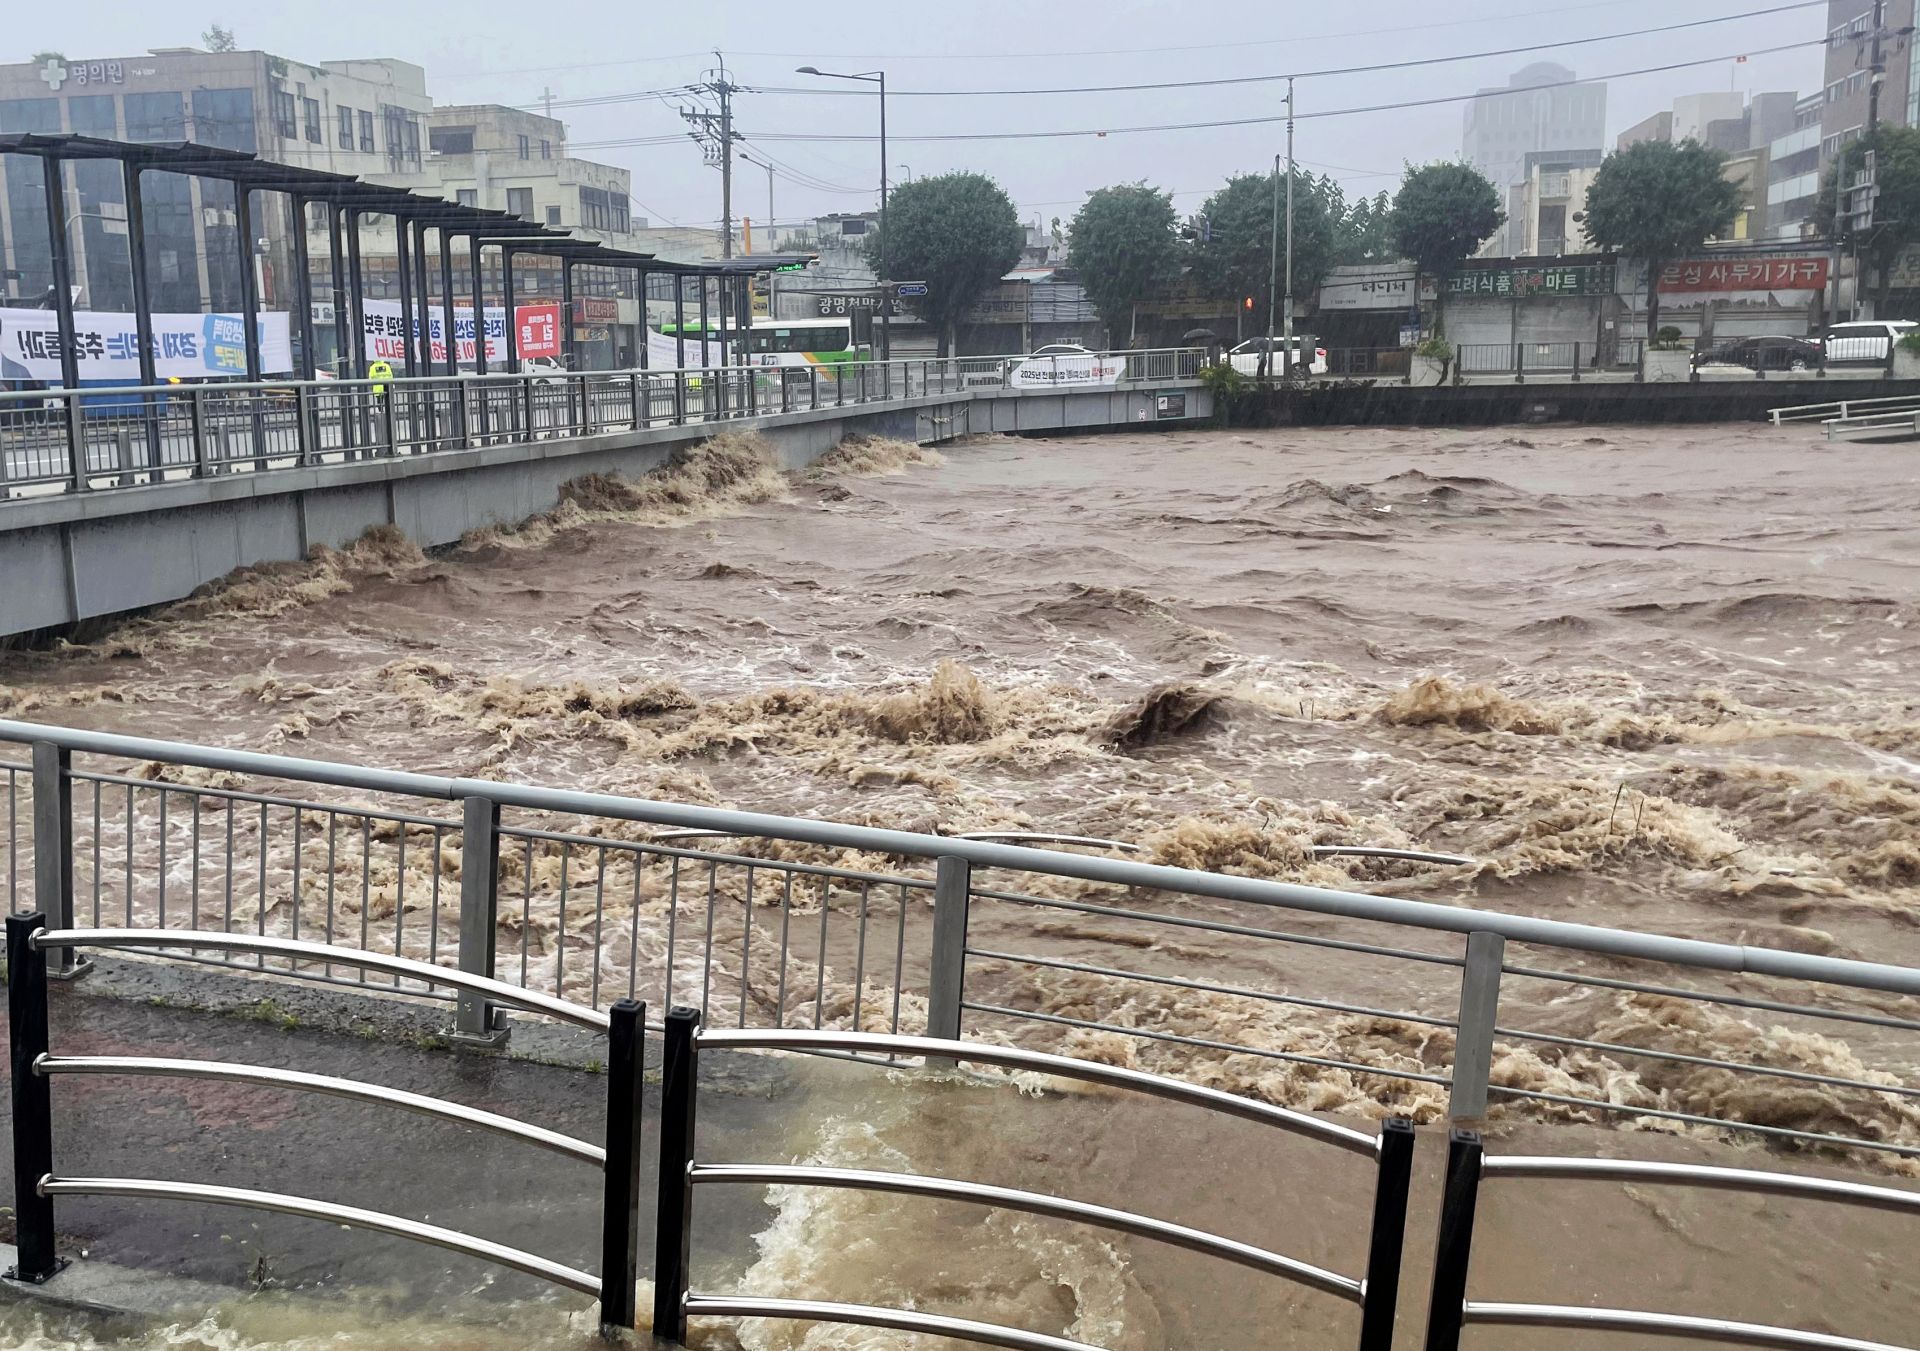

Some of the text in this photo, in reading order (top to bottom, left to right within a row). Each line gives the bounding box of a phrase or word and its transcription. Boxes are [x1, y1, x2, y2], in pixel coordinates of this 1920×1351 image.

[72, 62, 123, 85] 명의원
[1662, 261, 1820, 285] 은성 사무기 가구
